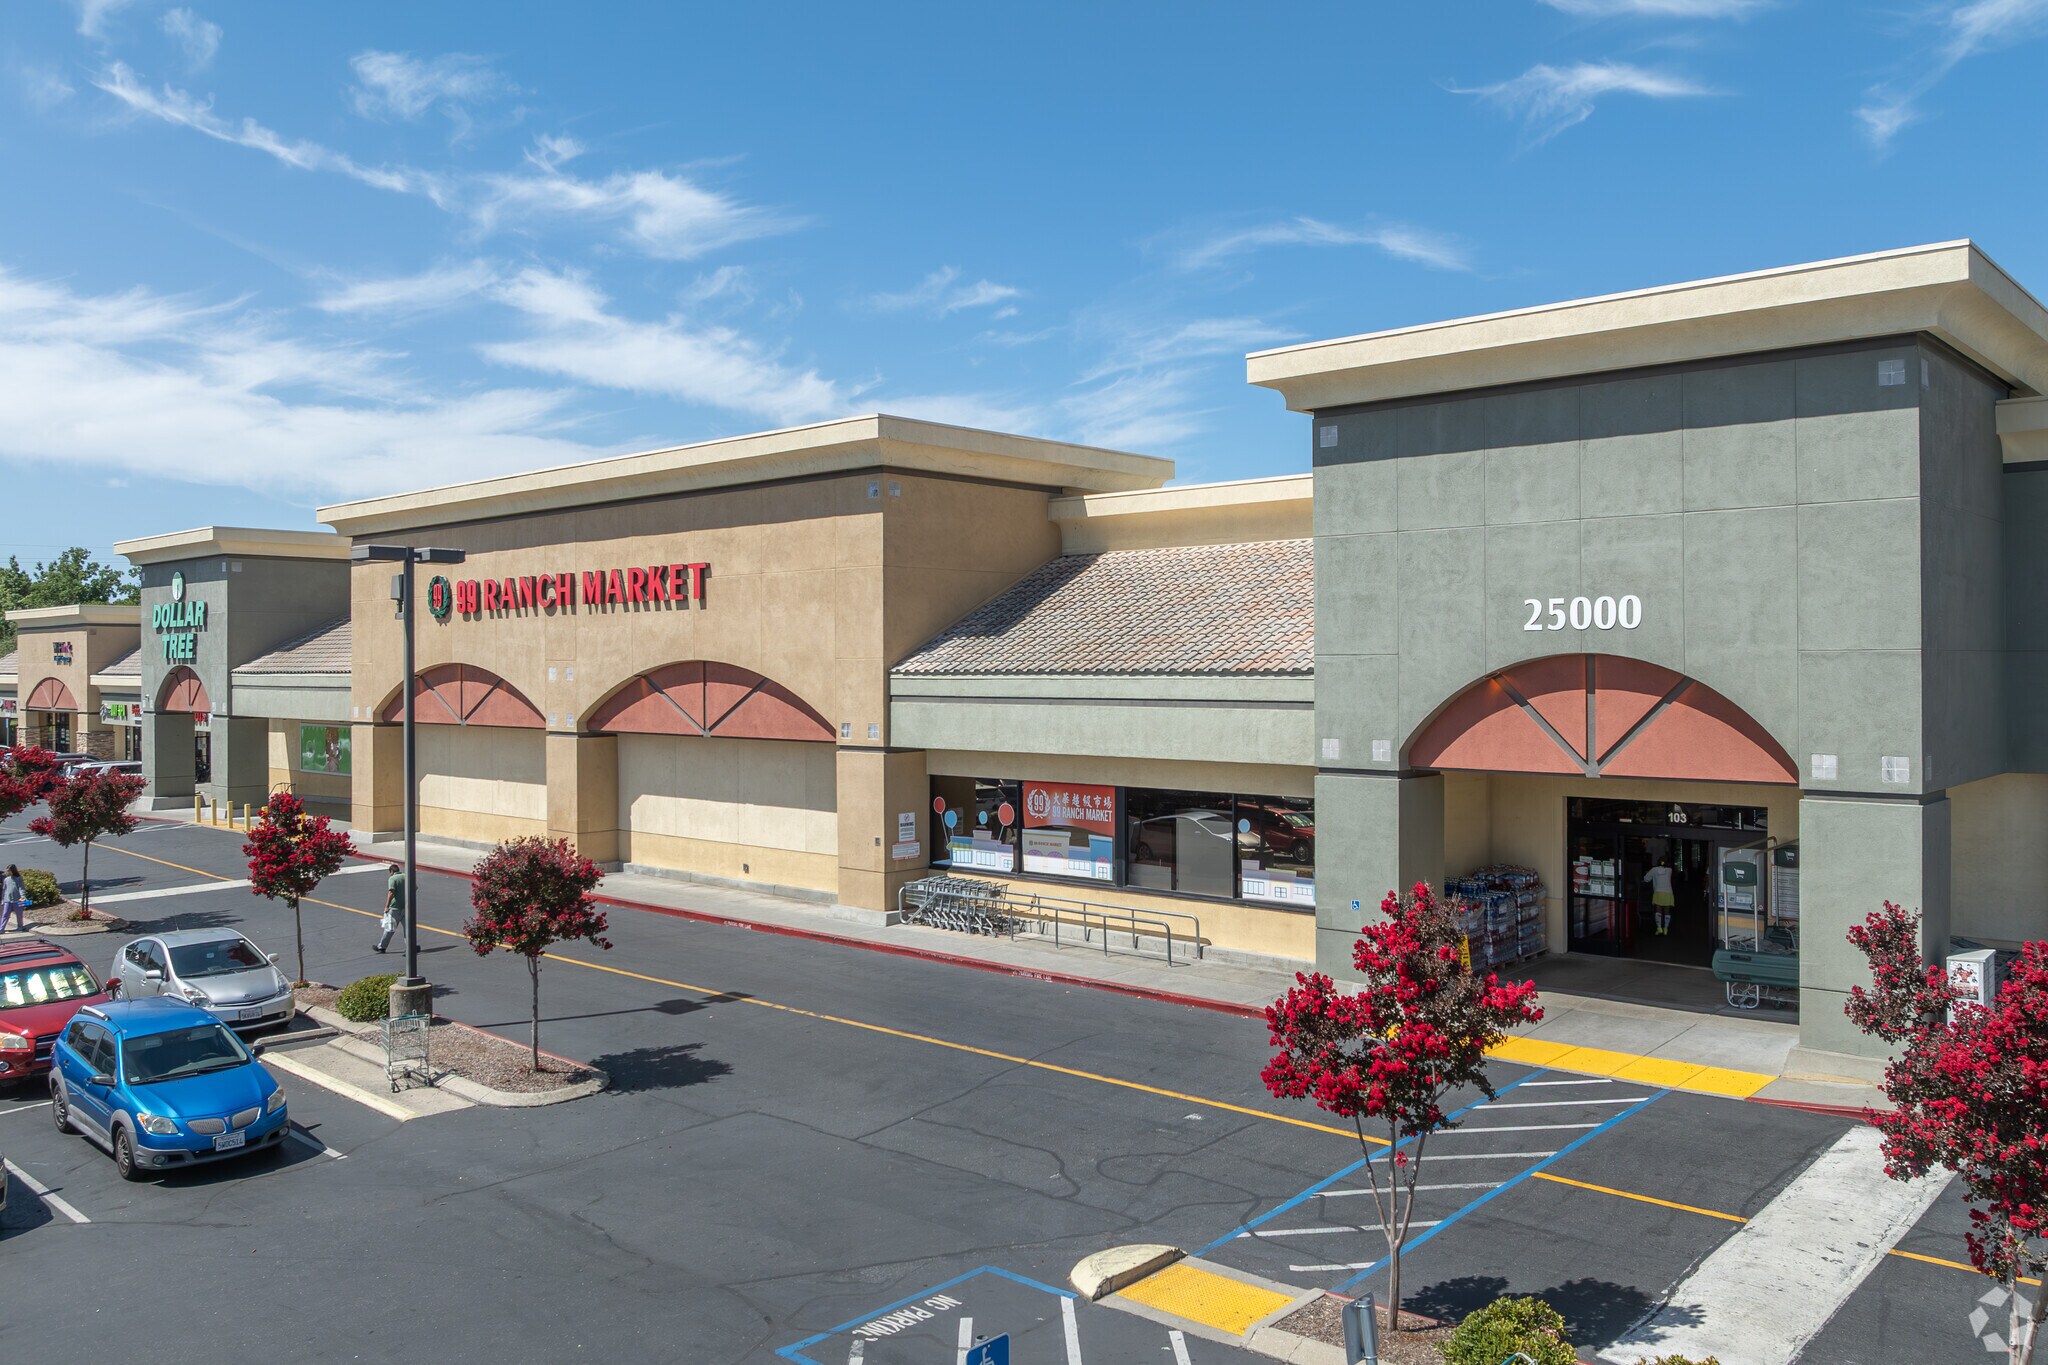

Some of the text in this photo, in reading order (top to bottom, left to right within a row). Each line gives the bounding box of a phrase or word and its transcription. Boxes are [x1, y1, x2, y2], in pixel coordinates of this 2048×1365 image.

[432, 583, 443, 608] 99
[456, 562, 707, 614] 99 RANCH MARKET
[152, 600, 206, 629] DOLLAR
[1523, 594, 1642, 631] 25000
[162, 633, 194, 659] TREE
[1034, 794, 1044, 812] 99
[1052, 806, 1113, 822] 99 RANCH MARKET
[1668, 812, 1687, 824] 103
